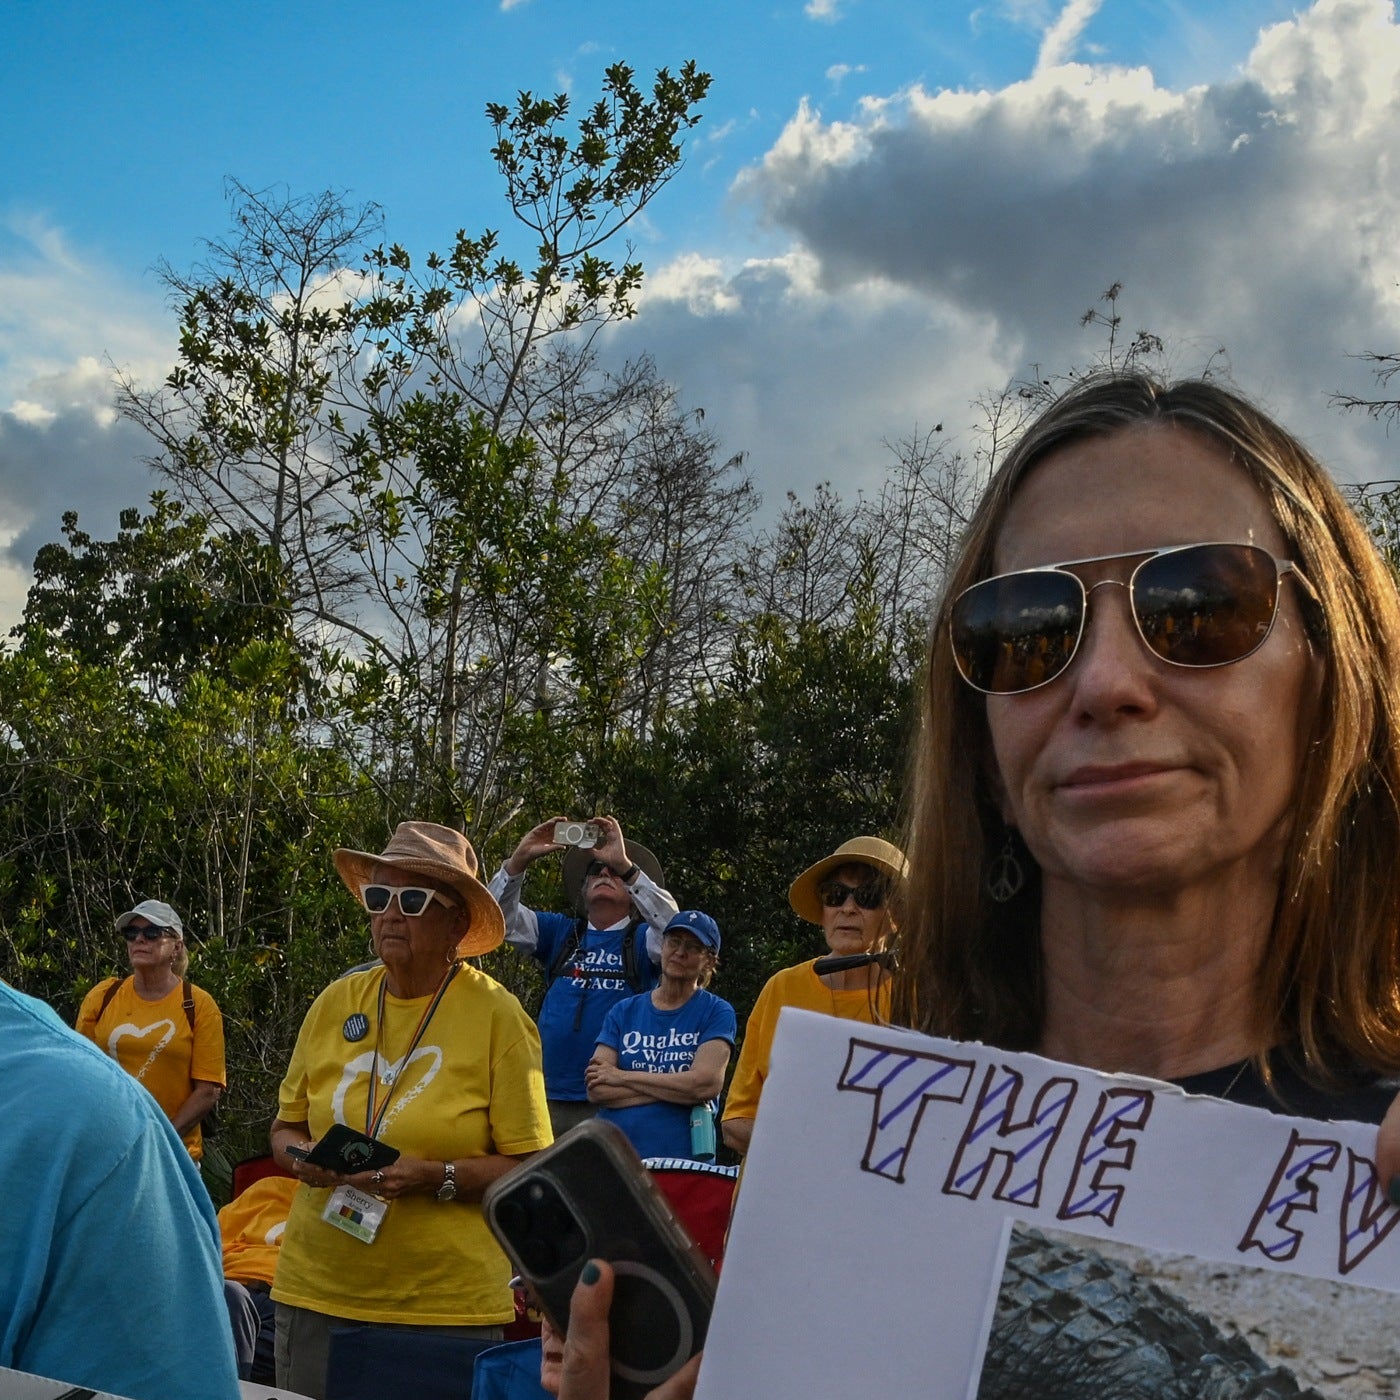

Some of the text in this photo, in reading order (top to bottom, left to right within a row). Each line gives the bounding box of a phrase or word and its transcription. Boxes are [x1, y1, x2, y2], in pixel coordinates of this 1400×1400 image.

[621, 1027, 700, 1055] Quaker
[631, 1059, 647, 1070] for
[641, 1048, 697, 1064] Witnes
[647, 1063, 691, 1074] PEAC
[837, 1037, 1156, 1227] THE
[344, 1189, 374, 1211] Sherry
